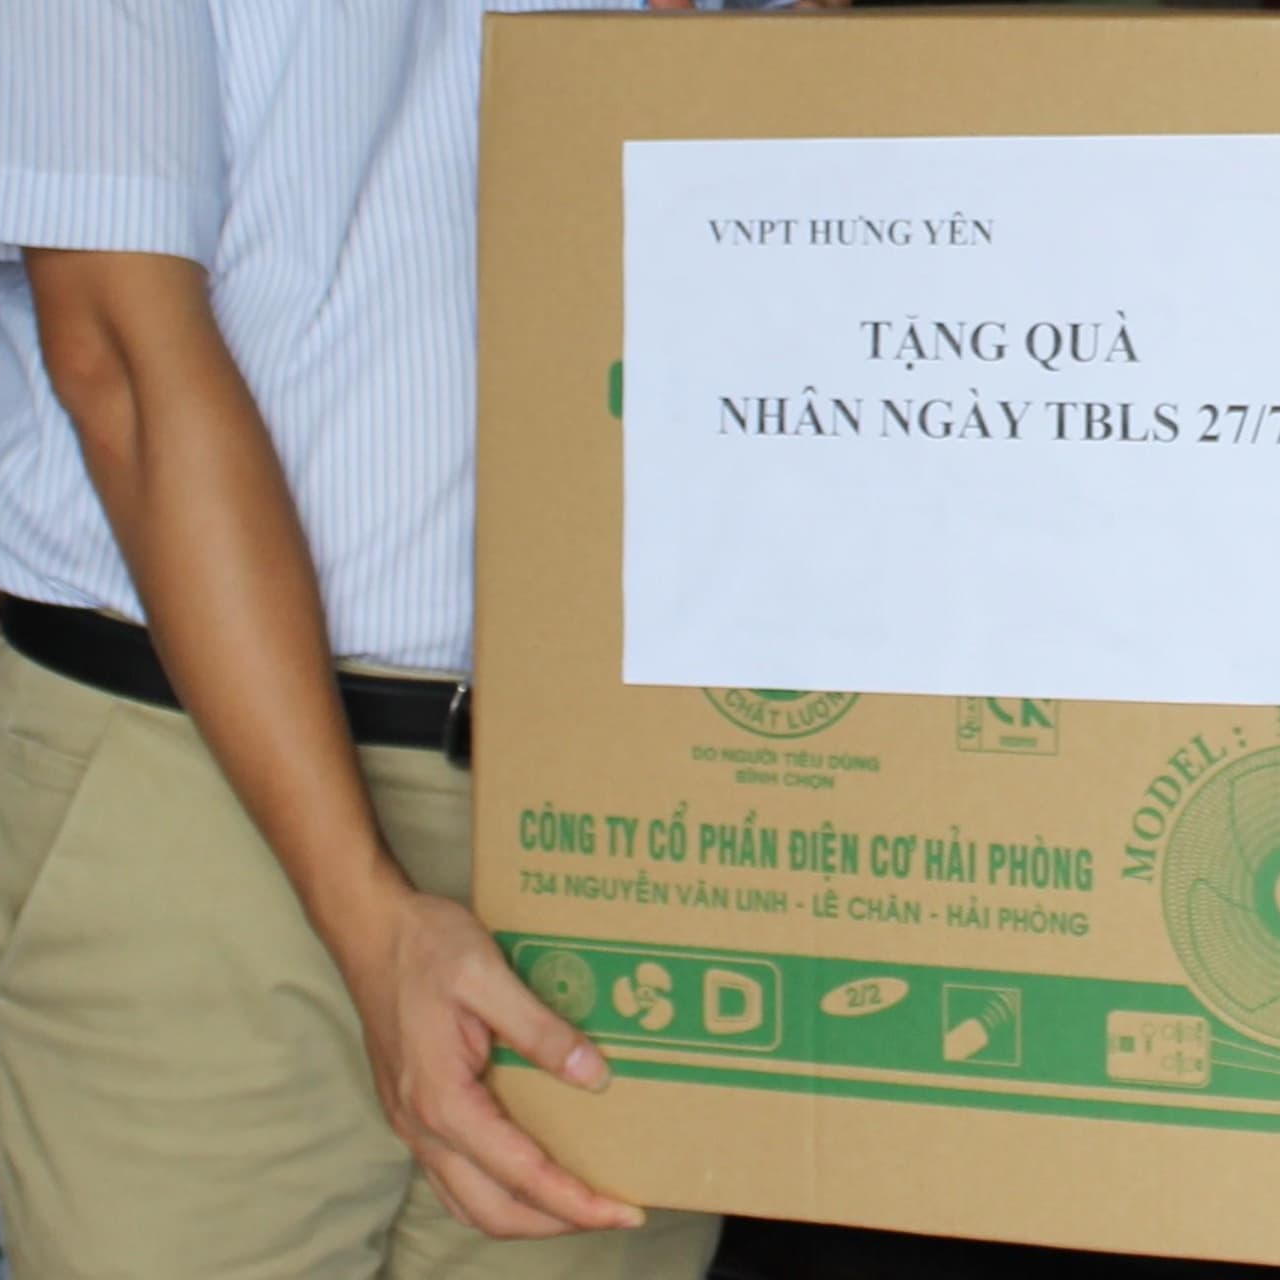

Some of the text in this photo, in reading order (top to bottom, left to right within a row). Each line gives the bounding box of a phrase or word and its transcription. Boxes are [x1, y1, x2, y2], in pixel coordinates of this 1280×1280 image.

[707, 211, 994, 246] VNPT HƯNG YÊN
[860, 310, 1140, 372] TẶNG QUÀ
[718, 385, 863, 436] NHÂN
[880, 388, 1032, 439] NGÀY
[1045, 401, 1181, 442] TBLS
[520, 801, 596, 856] CÔNG
[604, 814, 640, 859] TY
[648, 799, 689, 863] CỔ
[788, 821, 859, 882] ĐIỆN
[871, 833, 918, 878] CƠ
[925, 824, 976, 884] HẢI
[988, 834, 1094, 892] PHÒNG
[521, 870, 558, 896] 734
[564, 869, 670, 907] NGUYỄN
[736, 887, 788, 914] LINH
[812, 888, 839, 919] LÊ
[846, 894, 922, 924] CHÂN
[946, 896, 991, 930] HẢI
[997, 903, 1090, 937] PHÒNG
[845, 983, 883, 1010] 2/2
